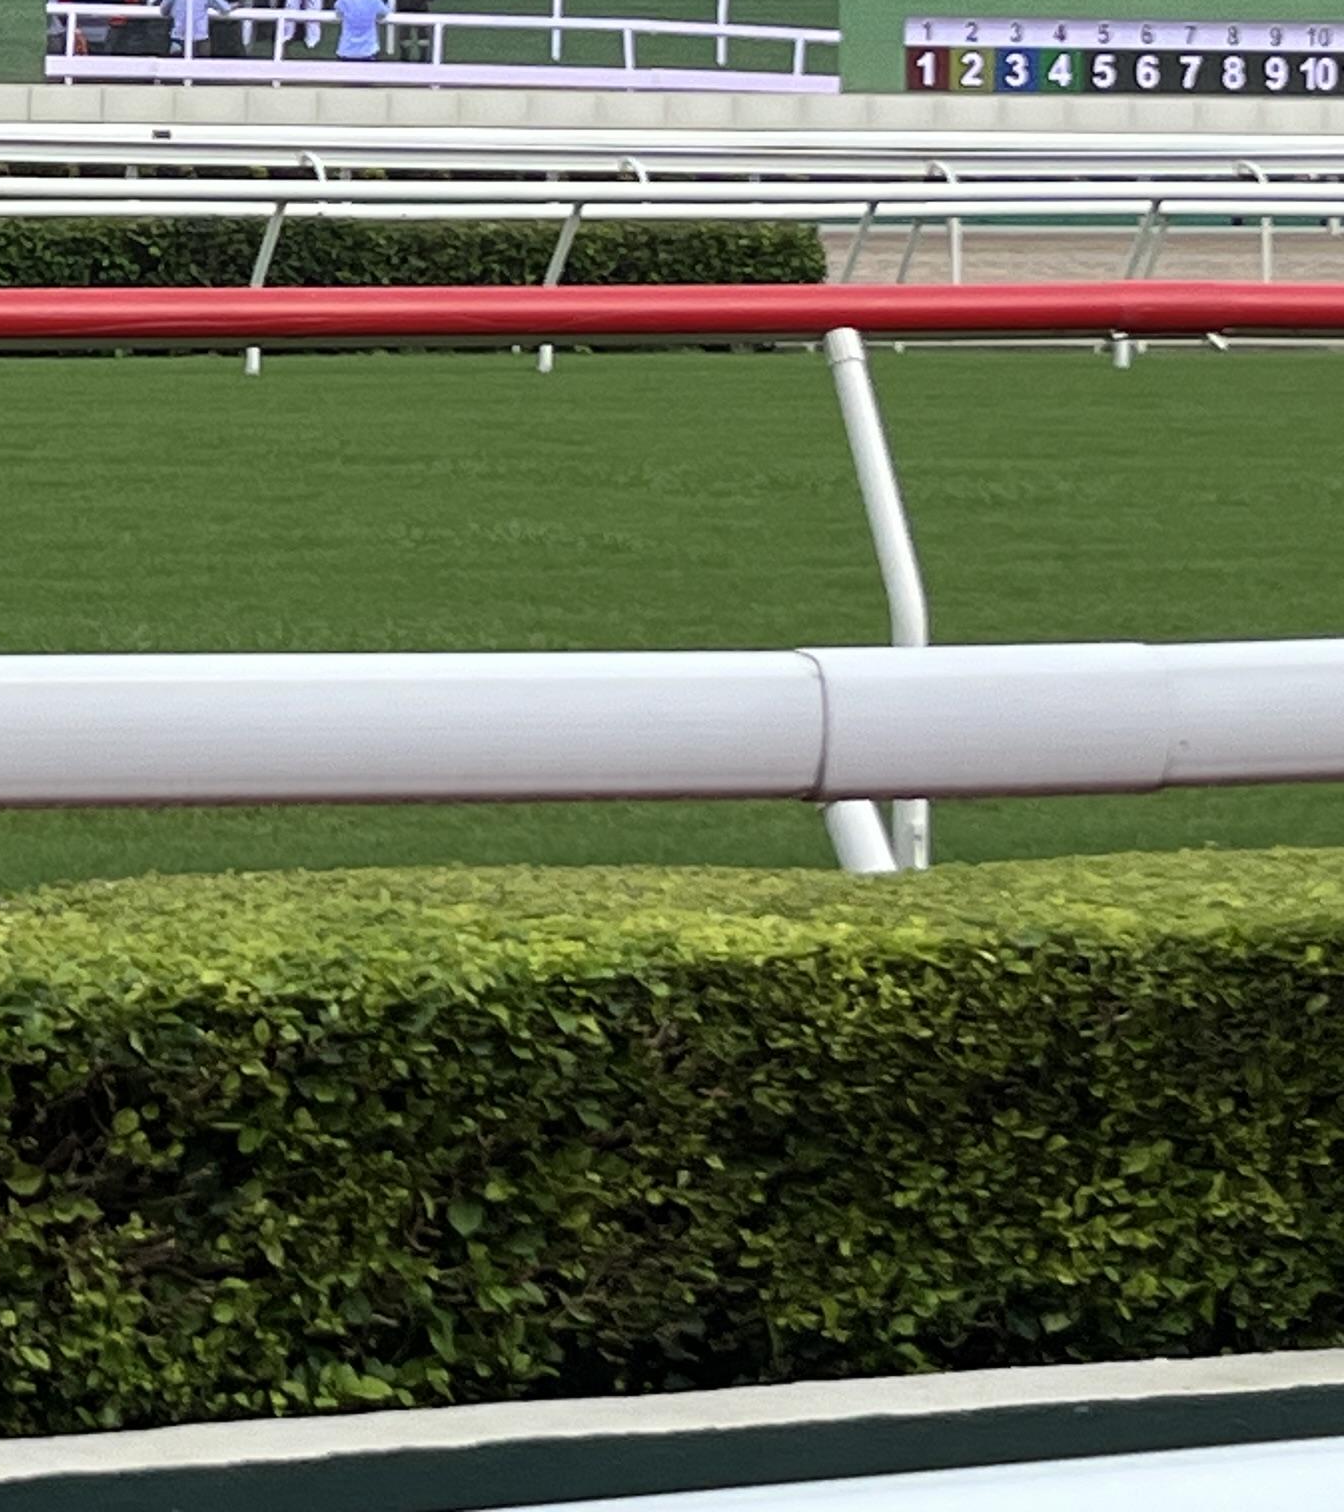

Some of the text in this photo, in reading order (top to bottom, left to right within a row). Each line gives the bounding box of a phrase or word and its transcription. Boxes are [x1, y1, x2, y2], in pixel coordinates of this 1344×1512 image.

[921, 21, 1332, 47] 1 2 3 4 5 6 7 8 9 10
[916, 52, 1338, 91] 1 2 3 4 5 6 7 8 9 10
